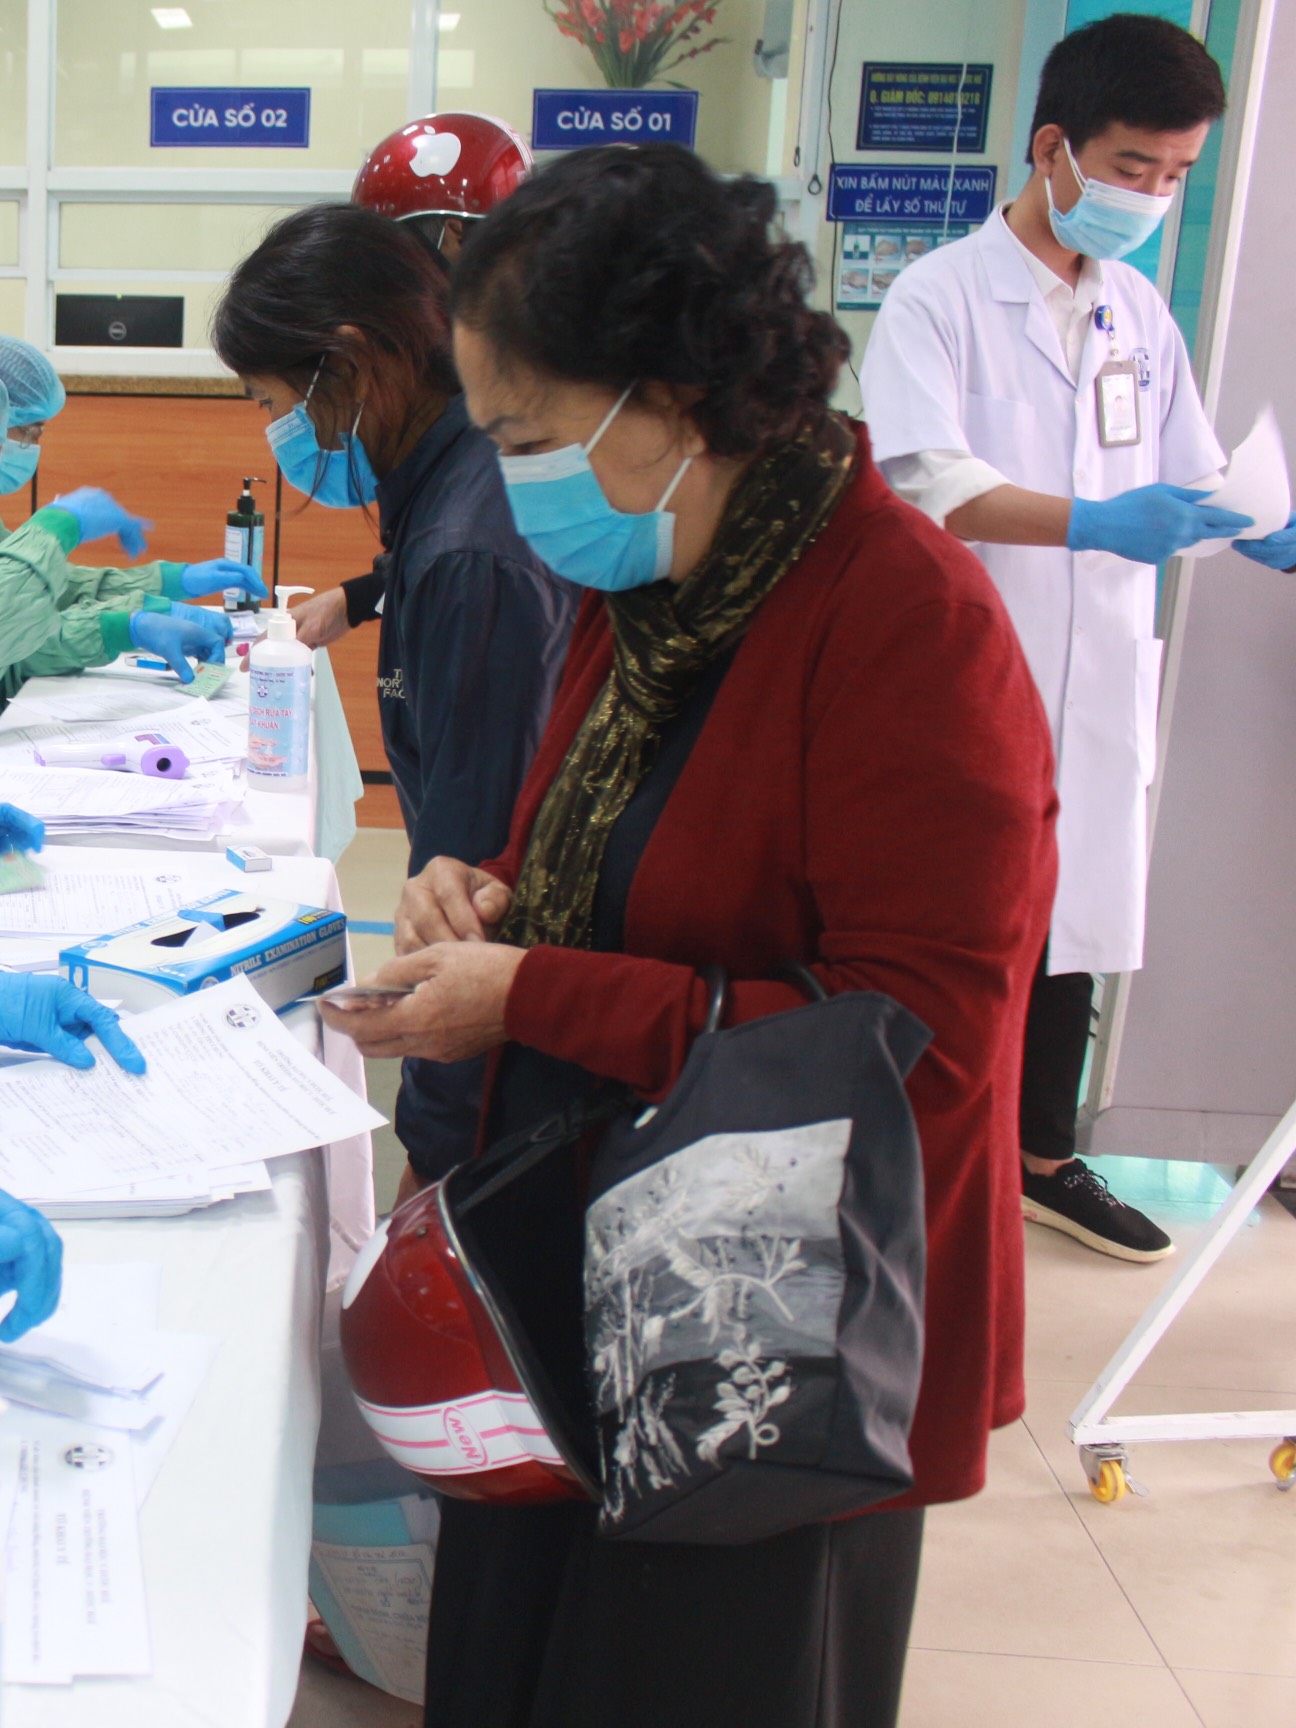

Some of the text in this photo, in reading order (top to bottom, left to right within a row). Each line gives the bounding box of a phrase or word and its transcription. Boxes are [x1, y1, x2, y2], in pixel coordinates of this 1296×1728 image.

[172, 102, 287, 127] CỬA SỐ 02
[557, 105, 671, 131] CỬA SỐ 01
[836, 176, 857, 189] XIN
[861, 172, 889, 190] BẤM
[892, 174, 917, 190] NÚT
[953, 178, 989, 191] XANH
[904, 195, 921, 213] SỐ
[376, 677, 401, 688] NOR
[383, 688, 406, 698] FAC
[230, 954, 263, 978] NITRILE
[265, 930, 318, 962] EXAMINATION
[319, 918, 346, 938] GLOVES
